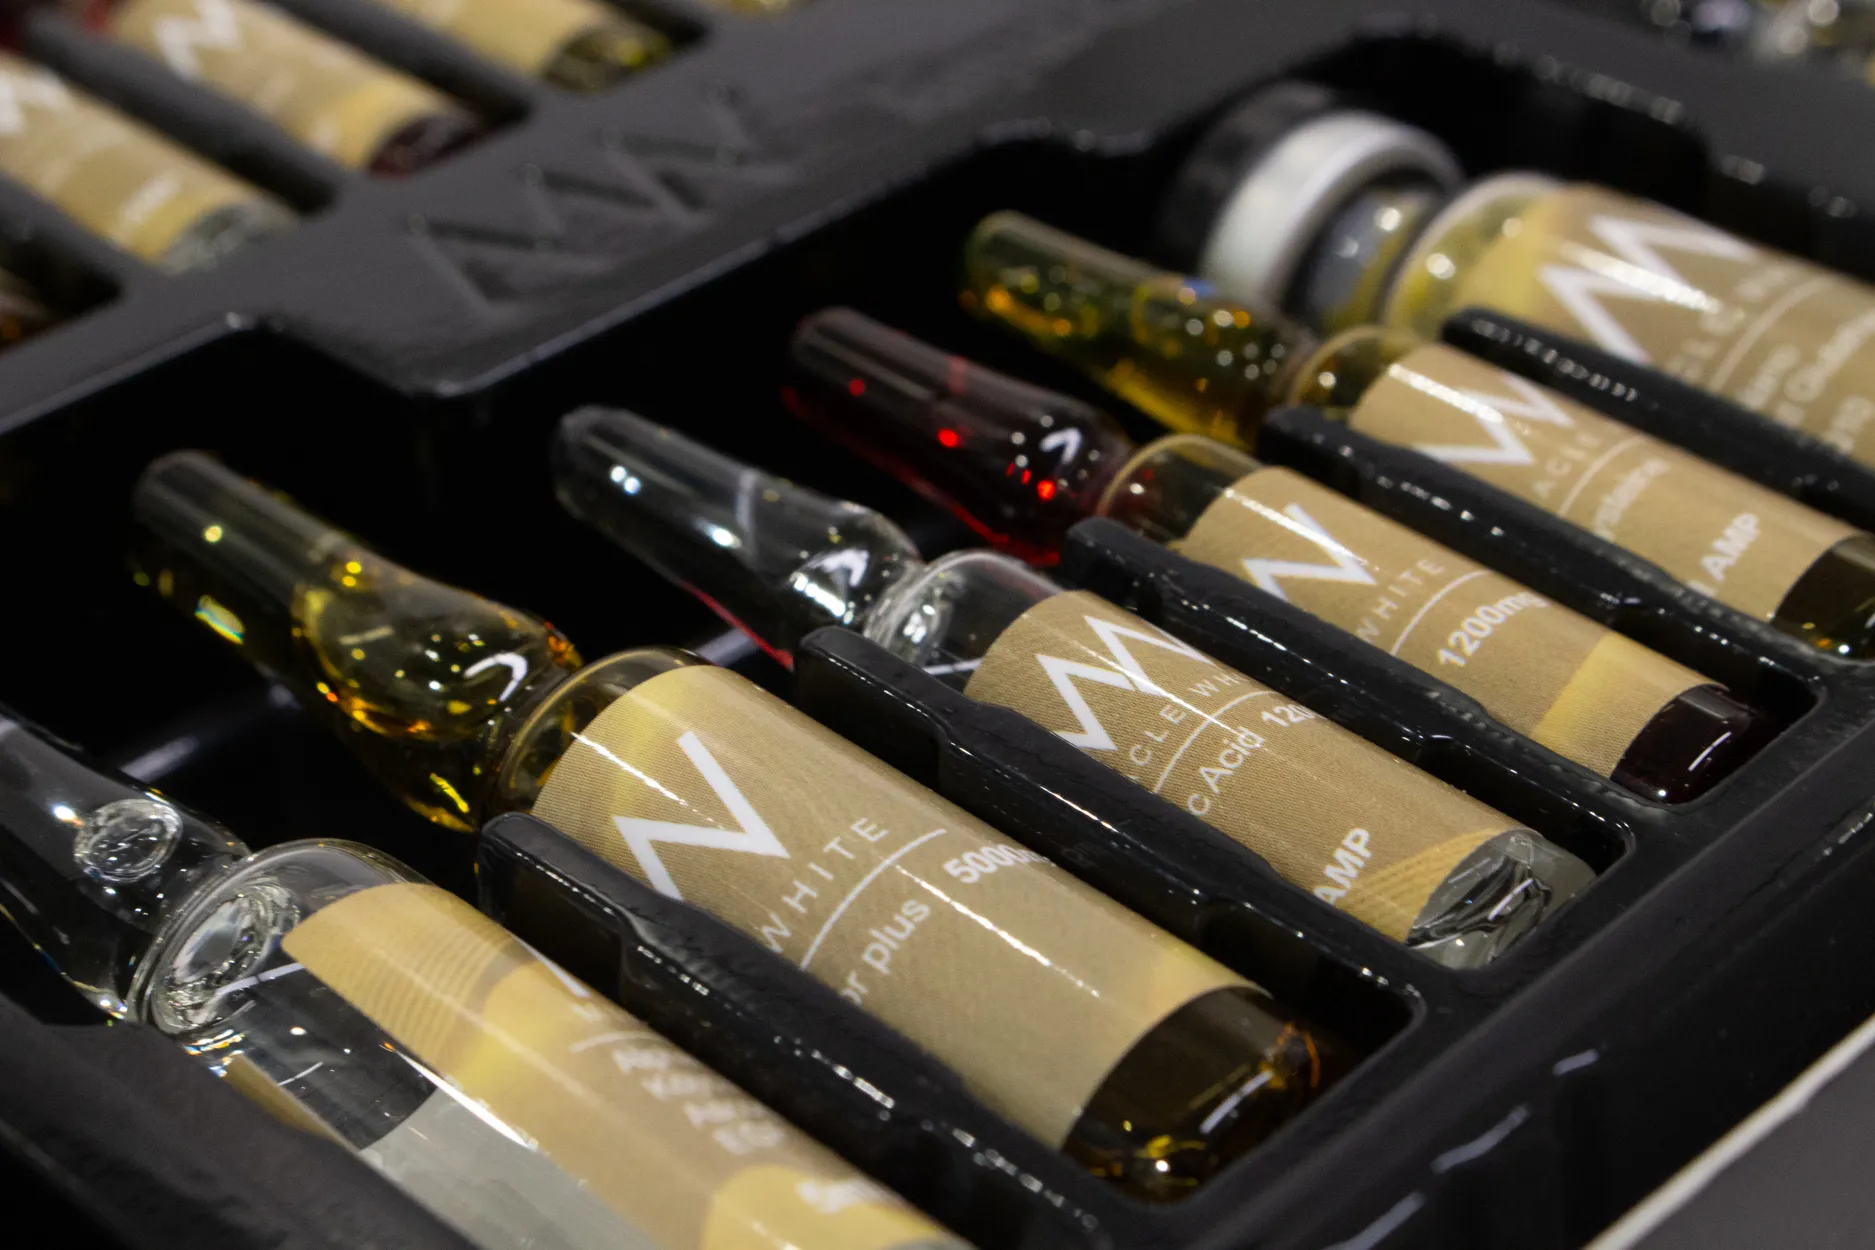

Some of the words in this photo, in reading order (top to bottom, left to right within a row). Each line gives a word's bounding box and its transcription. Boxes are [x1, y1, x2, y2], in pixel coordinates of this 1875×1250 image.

[1701, 512, 1760, 583] AMP
[1356, 559, 1444, 644] WHITE
[1198, 725, 1265, 794] Acid
[764, 818, 889, 953] WHITE
[1313, 827, 1372, 906] AMP
[861, 898, 931, 974] plus
